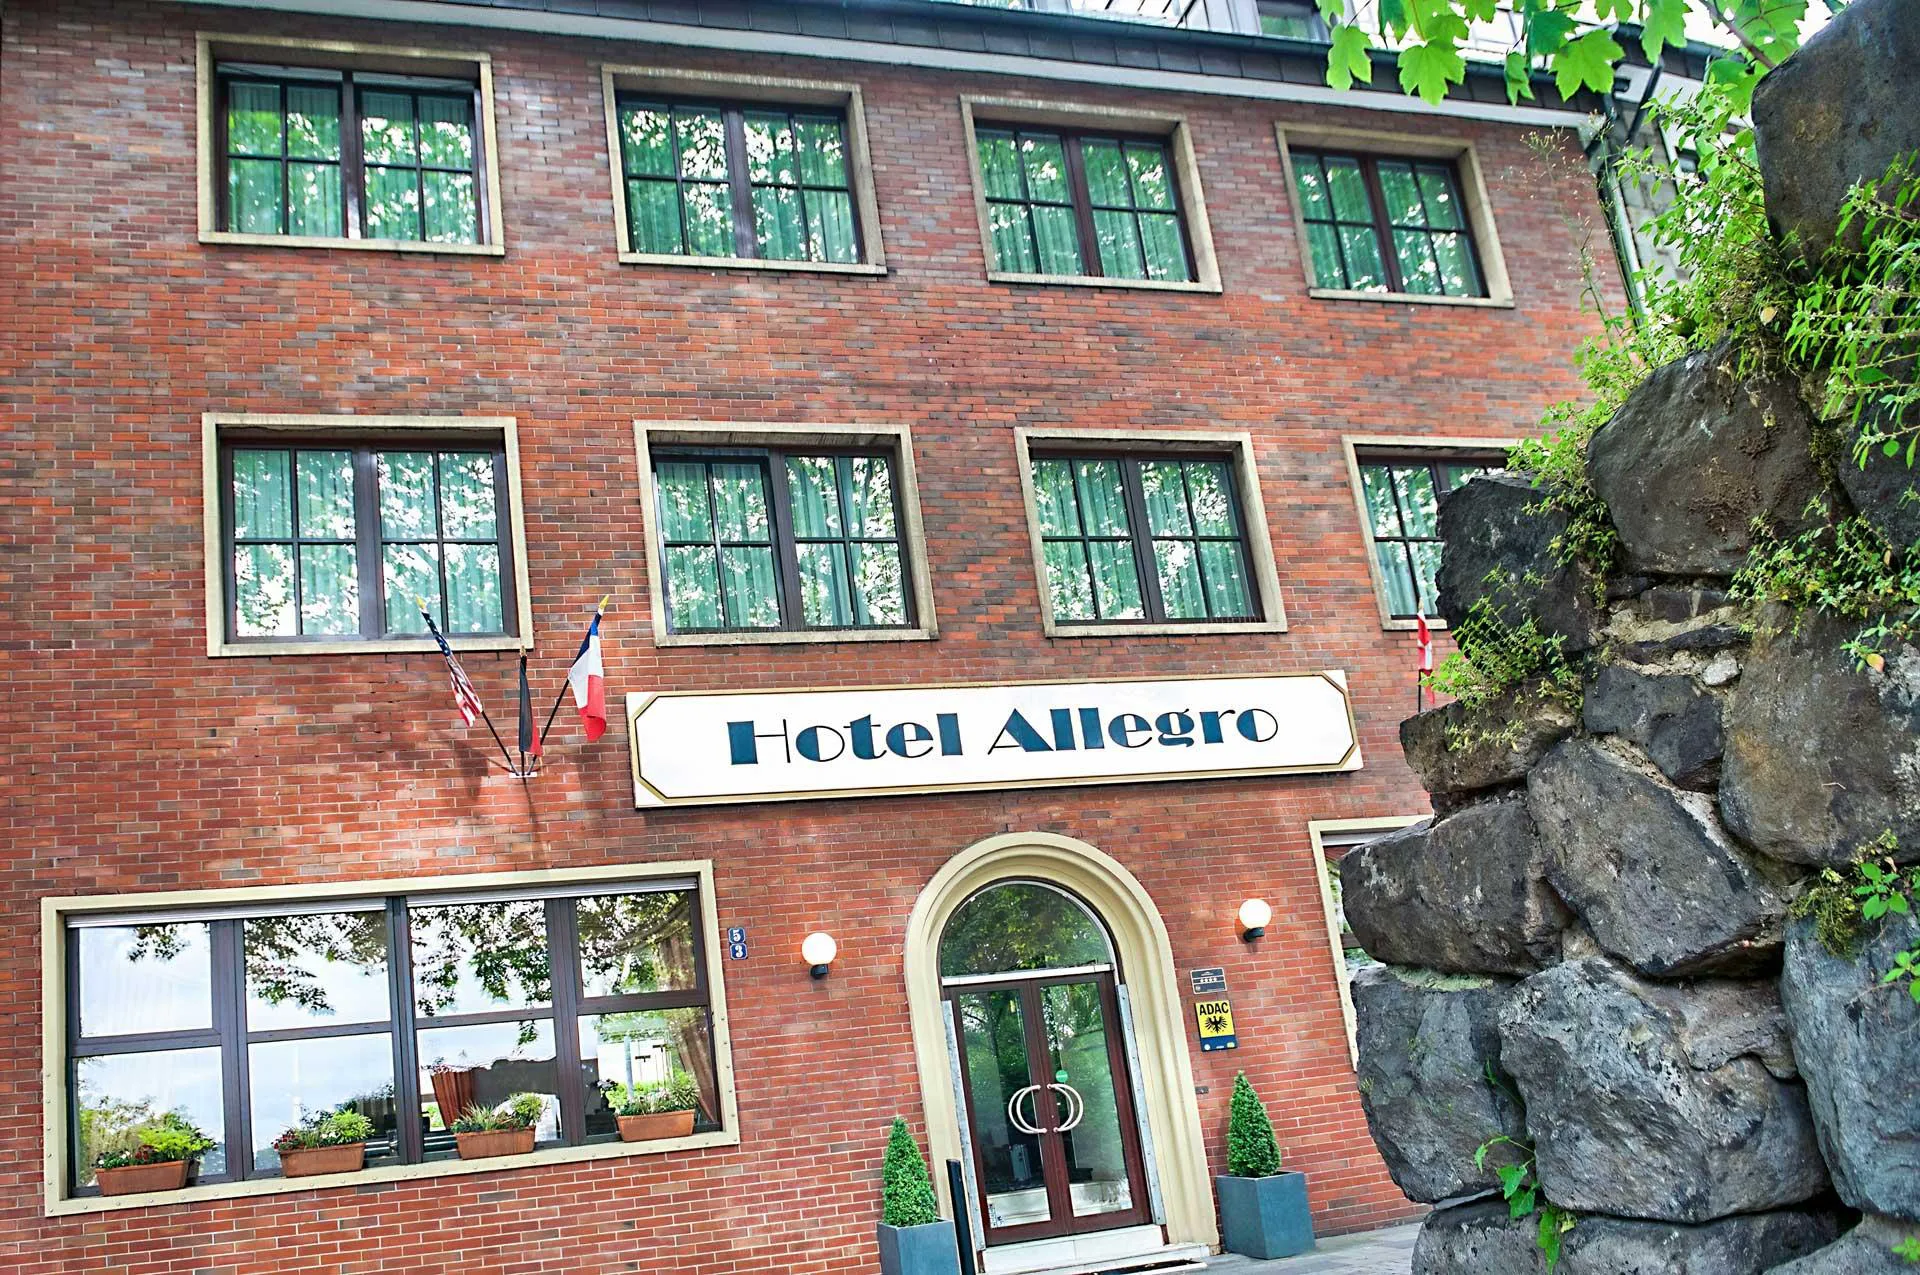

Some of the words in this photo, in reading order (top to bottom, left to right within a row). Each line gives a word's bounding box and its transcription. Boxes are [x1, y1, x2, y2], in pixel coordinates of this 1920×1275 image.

[727, 713, 963, 765] Hotel
[987, 707, 1278, 755] Allegro
[1200, 1002, 1229, 1015] ADAC
